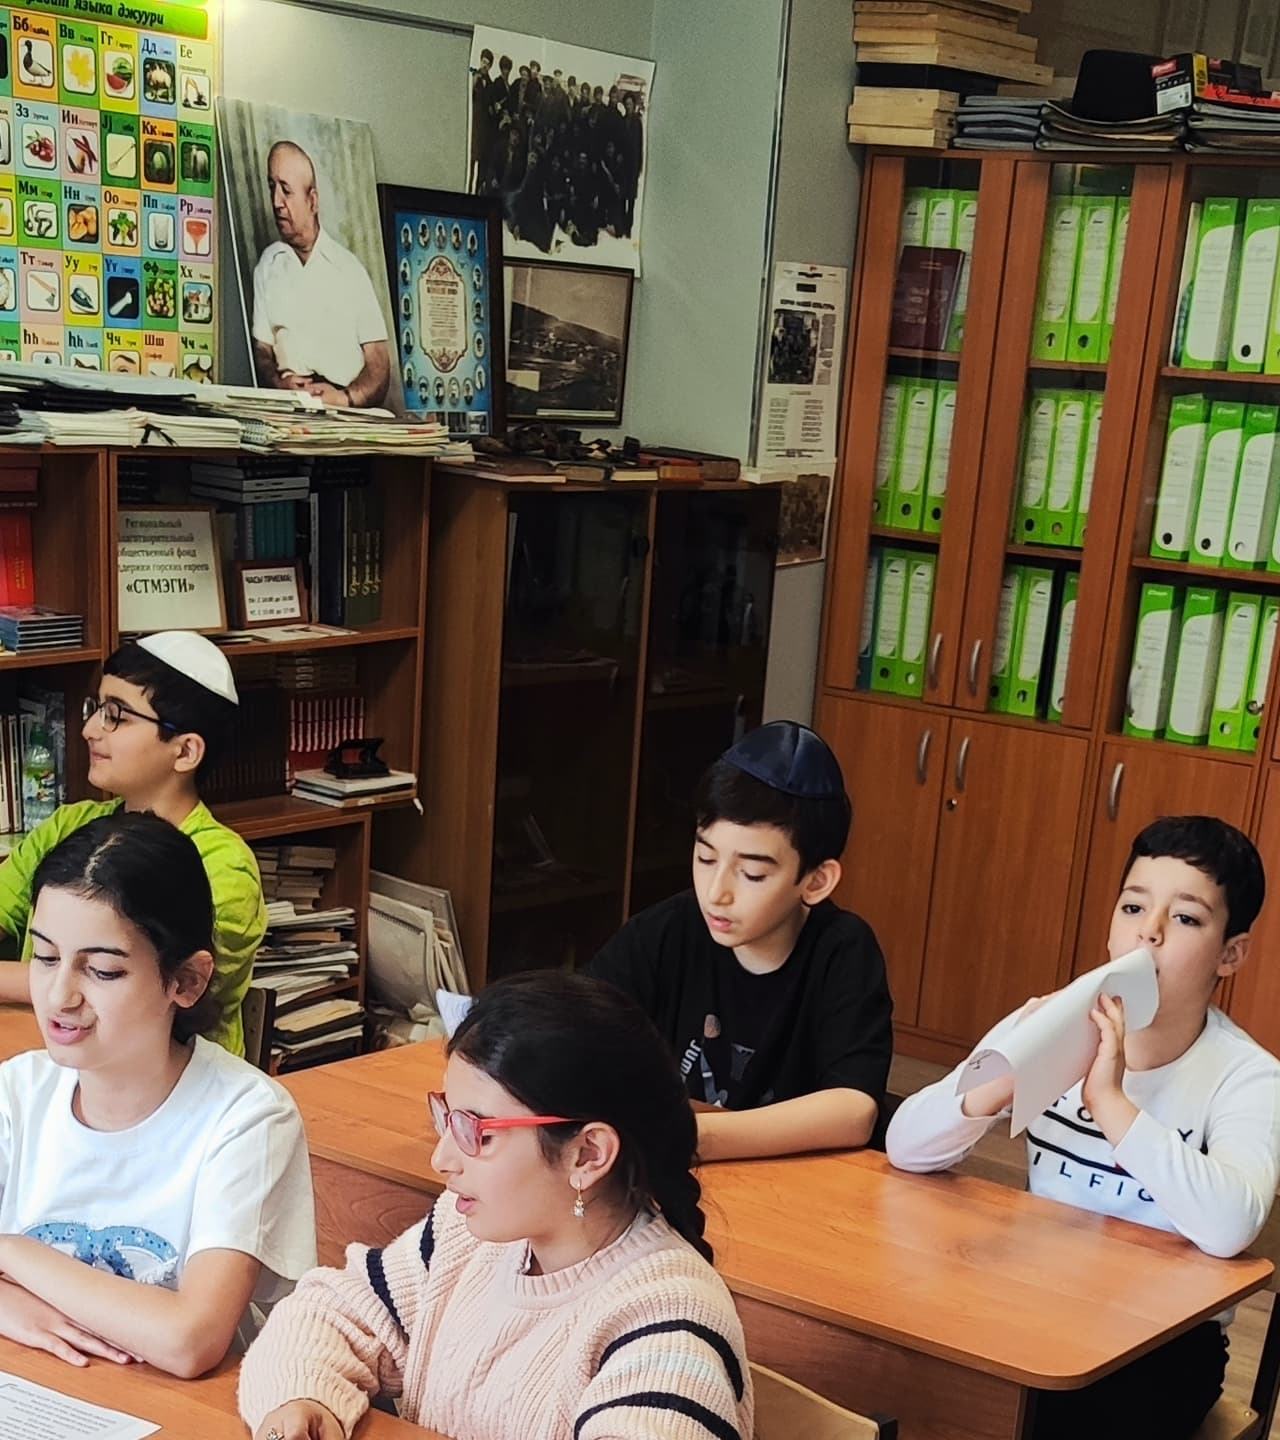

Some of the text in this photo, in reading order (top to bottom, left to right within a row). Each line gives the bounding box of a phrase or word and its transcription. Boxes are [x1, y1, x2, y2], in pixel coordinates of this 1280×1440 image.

[118, 2, 164, 25] джуури
[13, 16, 29, 30] Бб
[59, 24, 75, 40] Вв
[101, 31, 113, 45] Гг
[141, 39, 157, 54] Дд
[180, 45, 192, 58] Ее
[15, 103, 29, 117] Зз
[62, 110, 79, 124] Ии
[142, 121, 157, 135] Кк
[18, 181, 38, 196] Мм
[64, 186, 80, 200] Нн
[104, 191, 119, 204] Оо
[143, 195, 158, 209] Пп
[180, 199, 193, 215] Рр
[21, 252, 35, 265] Тт
[65, 256, 80, 271] Уу
[180, 265, 193, 278] Хх
[145, 335, 164, 346] Шш
[126, 579, 195, 594] «СТМЭГИ»
